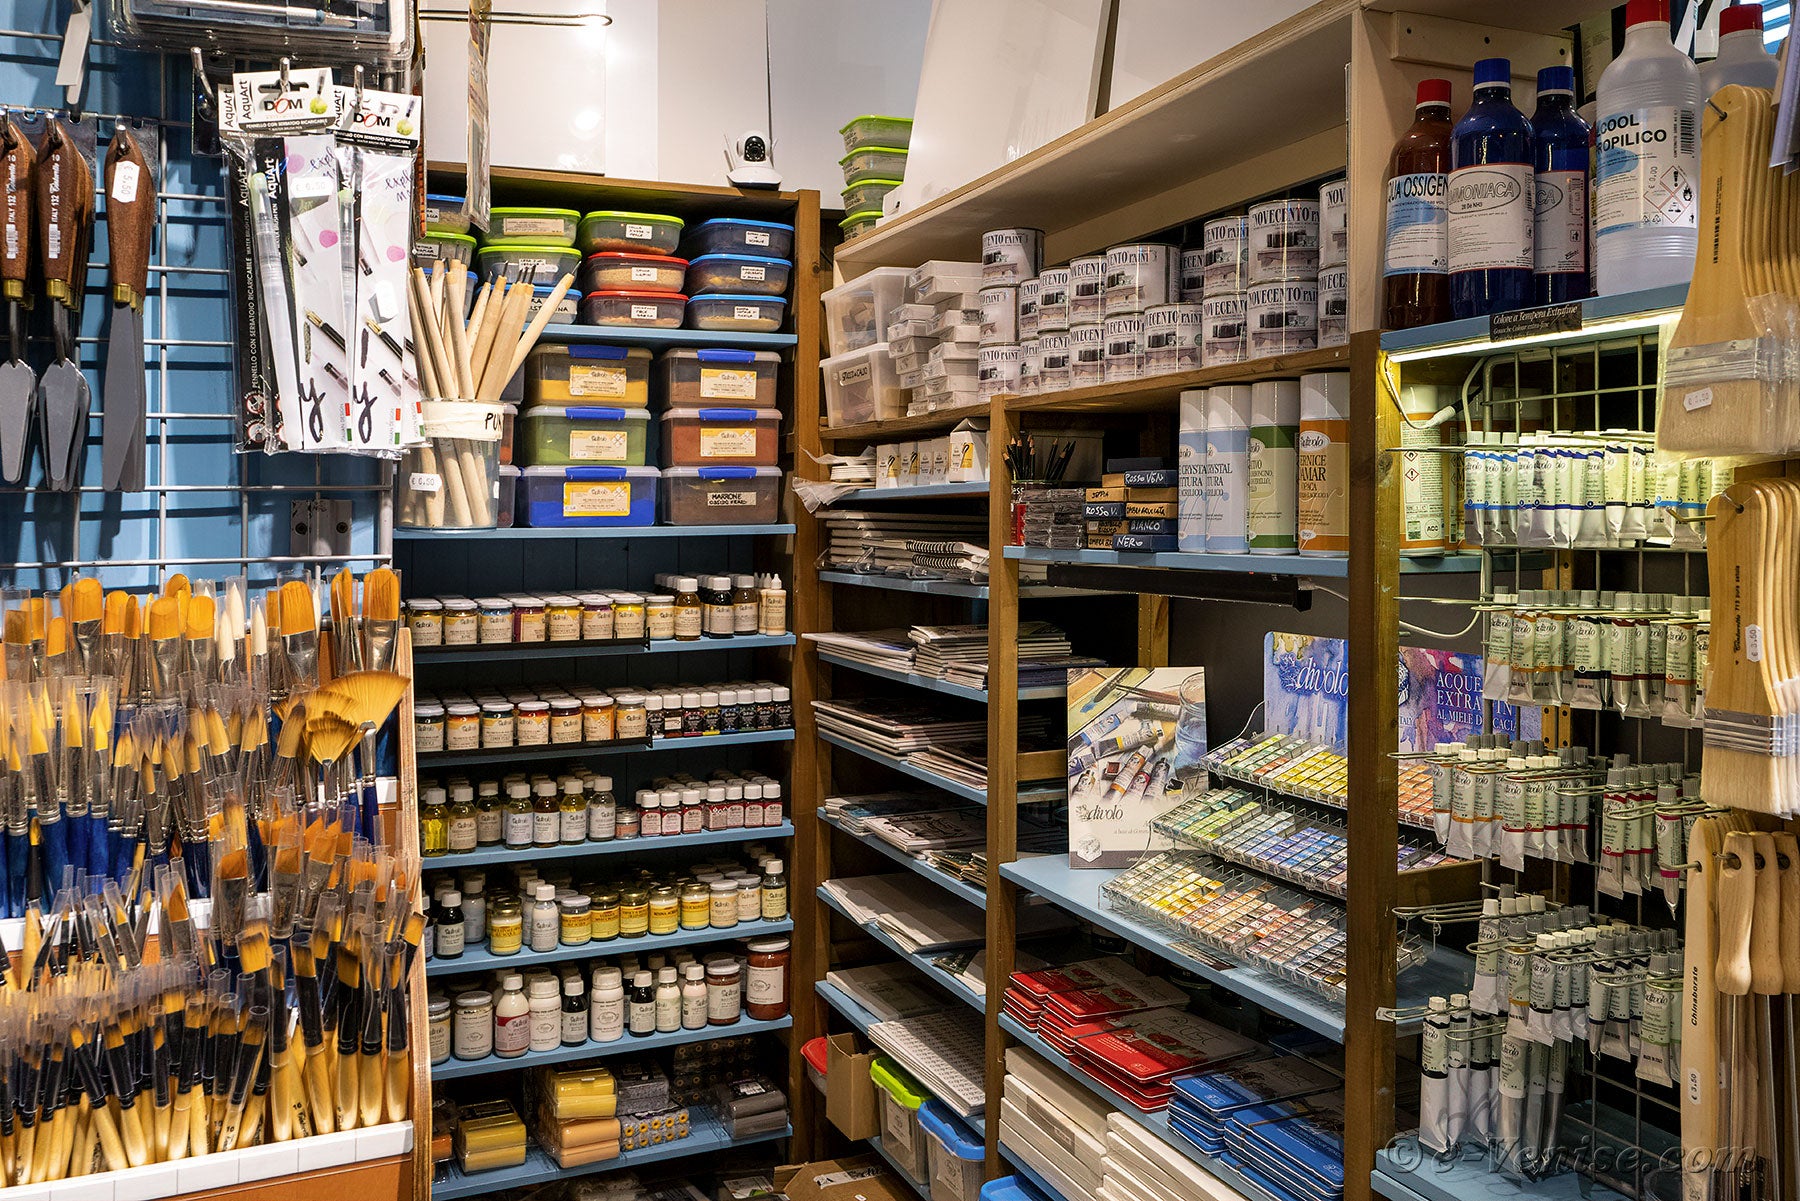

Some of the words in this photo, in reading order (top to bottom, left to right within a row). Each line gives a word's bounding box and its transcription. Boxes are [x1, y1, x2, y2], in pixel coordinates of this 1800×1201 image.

[222, 88, 234, 127] AquArt
[242, 80, 253, 120] AquArt
[265, 157, 278, 199] AquArt
[1253, 207, 1310, 226] NOVECENTO
[1086, 506, 1110, 517] ROSSO
[1130, 520, 1160, 531] BIANCO
[1116, 536, 1143, 548] NERO
[1436, 690, 1483, 712] EXTRA
[1436, 710, 1446, 720] AL
[1448, 712, 1474, 725] MIELE
[1088, 804, 1124, 821] divolo
